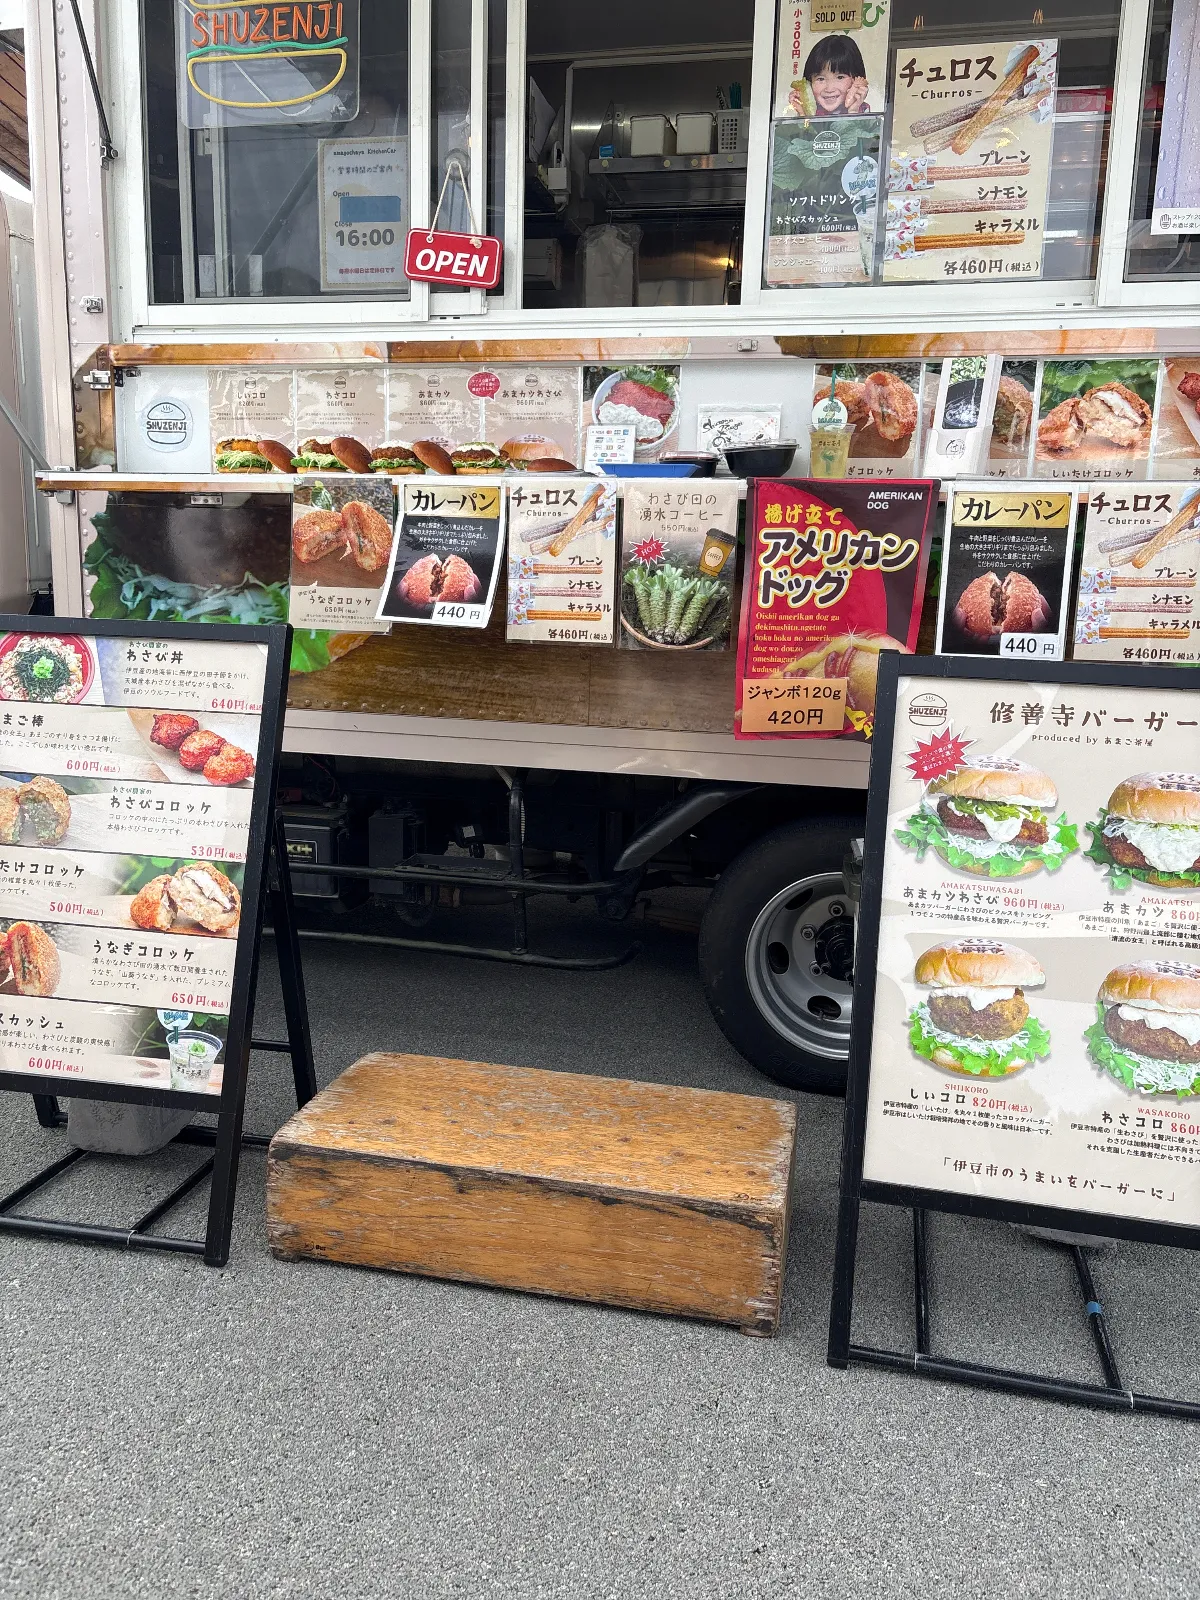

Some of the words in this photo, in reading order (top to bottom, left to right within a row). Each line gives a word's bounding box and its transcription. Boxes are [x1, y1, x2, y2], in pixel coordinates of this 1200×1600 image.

[815, 12, 836, 23] SOLD
[840, 10, 857, 21] OUT
[191, 3, 344, 47] SHUZENJI
[899, 55, 998, 88] チュロス
[980, 150, 1031, 165] プレーン
[977, 185, 1028, 200] シナモン
[789, 194, 857, 207] ソフトドリンク
[974, 219, 1040, 234] キャラメル
[336, 228, 395, 247] 16:00
[415, 247, 490, 278] OPEN
[418, 389, 451, 399] あまカツ
[146, 420, 188, 431] SHUZENJI
[1052, 468, 1134, 479] しいたけコロッケ
[411, 489, 497, 512] カレーパン
[511, 486, 578, 507] チュロス
[648, 493, 717, 506] わさび田の
[868, 491, 924, 501] AMERIKAN
[1090, 492, 1173, 514] チュロス
[867, 501, 890, 510] DOG
[959, 497, 1066, 521] カレーパン
[640, 507, 723, 522] 湧水コーヒー
[764, 503, 844, 525] 揚げ立て
[640, 542, 658, 556] HOT
[760, 527, 918, 572] アメリカン
[568, 555, 603, 565] プレーン
[1154, 567, 1198, 579] プレーン
[568, 579, 603, 590] シナモン
[760, 567, 850, 608] ドッグ
[309, 595, 372, 606] うなぎコロッケ
[1152, 593, 1194, 606] シナモン
[437, 605, 466, 618] 440
[469, 610, 481, 620] 円
[567, 602, 611, 613] キャラメル
[815, 613, 830, 622] dog
[1005, 638, 1037, 653] 440
[1043, 643, 1055, 654] 円
[126, 649, 183, 664] わさび丼
[747, 685, 841, 700] ジャンボ120g
[767, 709, 824, 725] 420円
[908, 707, 948, 716] SHUZENJI
[990, 701, 1198, 732] 修善寺バーガー
[1031, 734, 1081, 743] produced
[1086, 736, 1098, 745] by
[110, 795, 211, 814] わさびコロッケ
[903, 886, 1000, 905] あまカツわさび
[940, 882, 1023, 895] AMAKATSUWASABI
[1140, 896, 1194, 907] AMAKATSU
[1102, 901, 1164, 918] あまカツ
[93, 939, 194, 961] うなぎコロッケ
[910, 1088, 966, 1104] しいコロ
[1101, 1111, 1163, 1129] わさコロ
[1137, 1107, 1191, 1120] WASAKORO
[943, 1156, 1176, 1203] 「伊豆市のうまいをバーガーに」
